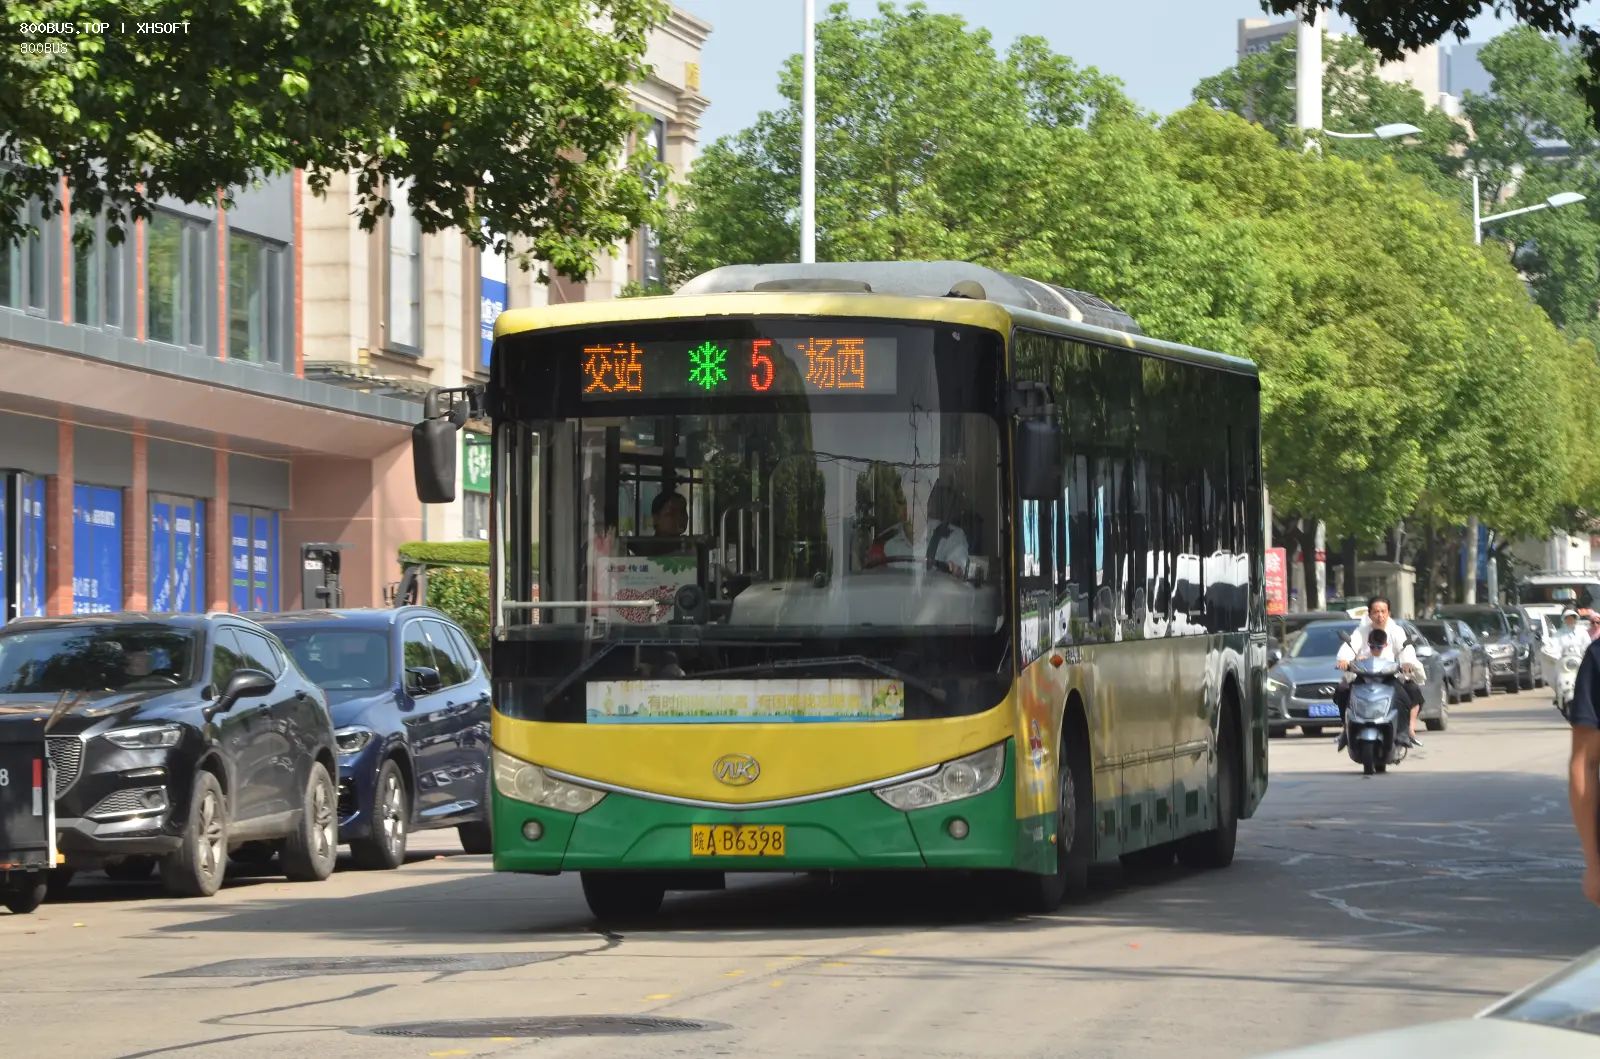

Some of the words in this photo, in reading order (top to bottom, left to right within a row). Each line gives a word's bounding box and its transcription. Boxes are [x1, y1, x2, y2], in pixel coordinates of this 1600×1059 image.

[582, 342, 643, 392] 交站
[751, 340, 773, 391] 5
[802, 337, 865, 389] 场西
